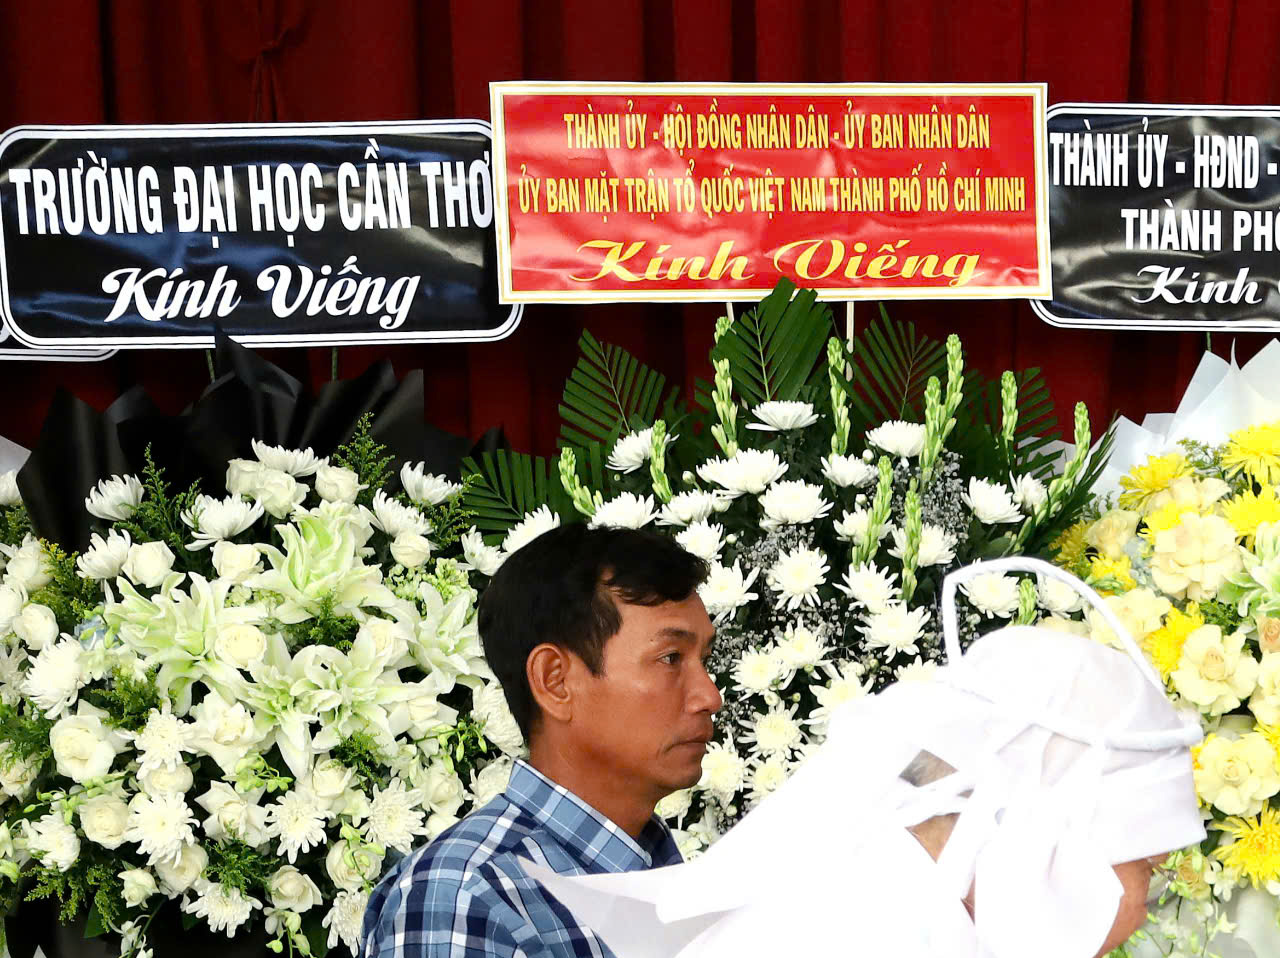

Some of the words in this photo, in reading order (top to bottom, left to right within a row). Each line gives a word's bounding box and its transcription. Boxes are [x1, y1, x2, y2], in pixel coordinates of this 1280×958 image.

[564, 104, 619, 149] THÀNH
[625, 101, 648, 148] ỦY
[664, 104, 693, 153] HỘI
[696, 98, 742, 149] ĐỒNG
[746, 106, 791, 149] NHÂN
[795, 106, 829, 149] DÂN
[844, 101, 867, 149] ỦY
[871, 113, 904, 149] BAN
[908, 104, 953, 149] NHÂN
[957, 104, 990, 149] DÂN
[1051, 119, 1128, 187] THÀNH
[1138, 116, 1169, 188] ỦY
[1194, 135, 1259, 190] HĐND
[9, 151, 164, 236] TRƯỜNG
[173, 165, 236, 249] ĐẠI
[250, 162, 326, 248] HỌC
[338, 137, 412, 231] CẦN
[421, 151, 493, 228] THƠ
[518, 164, 543, 212] ỦY
[547, 180, 580, 212] BAN
[584, 166, 619, 222] MẶT
[624, 171, 668, 219] TRẬN
[673, 159, 696, 212] TỔ
[700, 166, 745, 219] QUỐC
[750, 171, 786, 219] VIỆT
[791, 179, 826, 212] NAM
[831, 169, 885, 212] THÀNH
[889, 163, 922, 211] PHỐ
[926, 162, 949, 211] HỒ
[953, 167, 981, 211] CHÍ
[985, 178, 1025, 211] MINH
[1121, 198, 1222, 251] THÀNH
[101, 265, 241, 324] Kính
[257, 255, 421, 330] Viếng
[570, 239, 755, 282] Kính
[774, 239, 985, 287] Viếng
[1130, 265, 1263, 305] Kính
